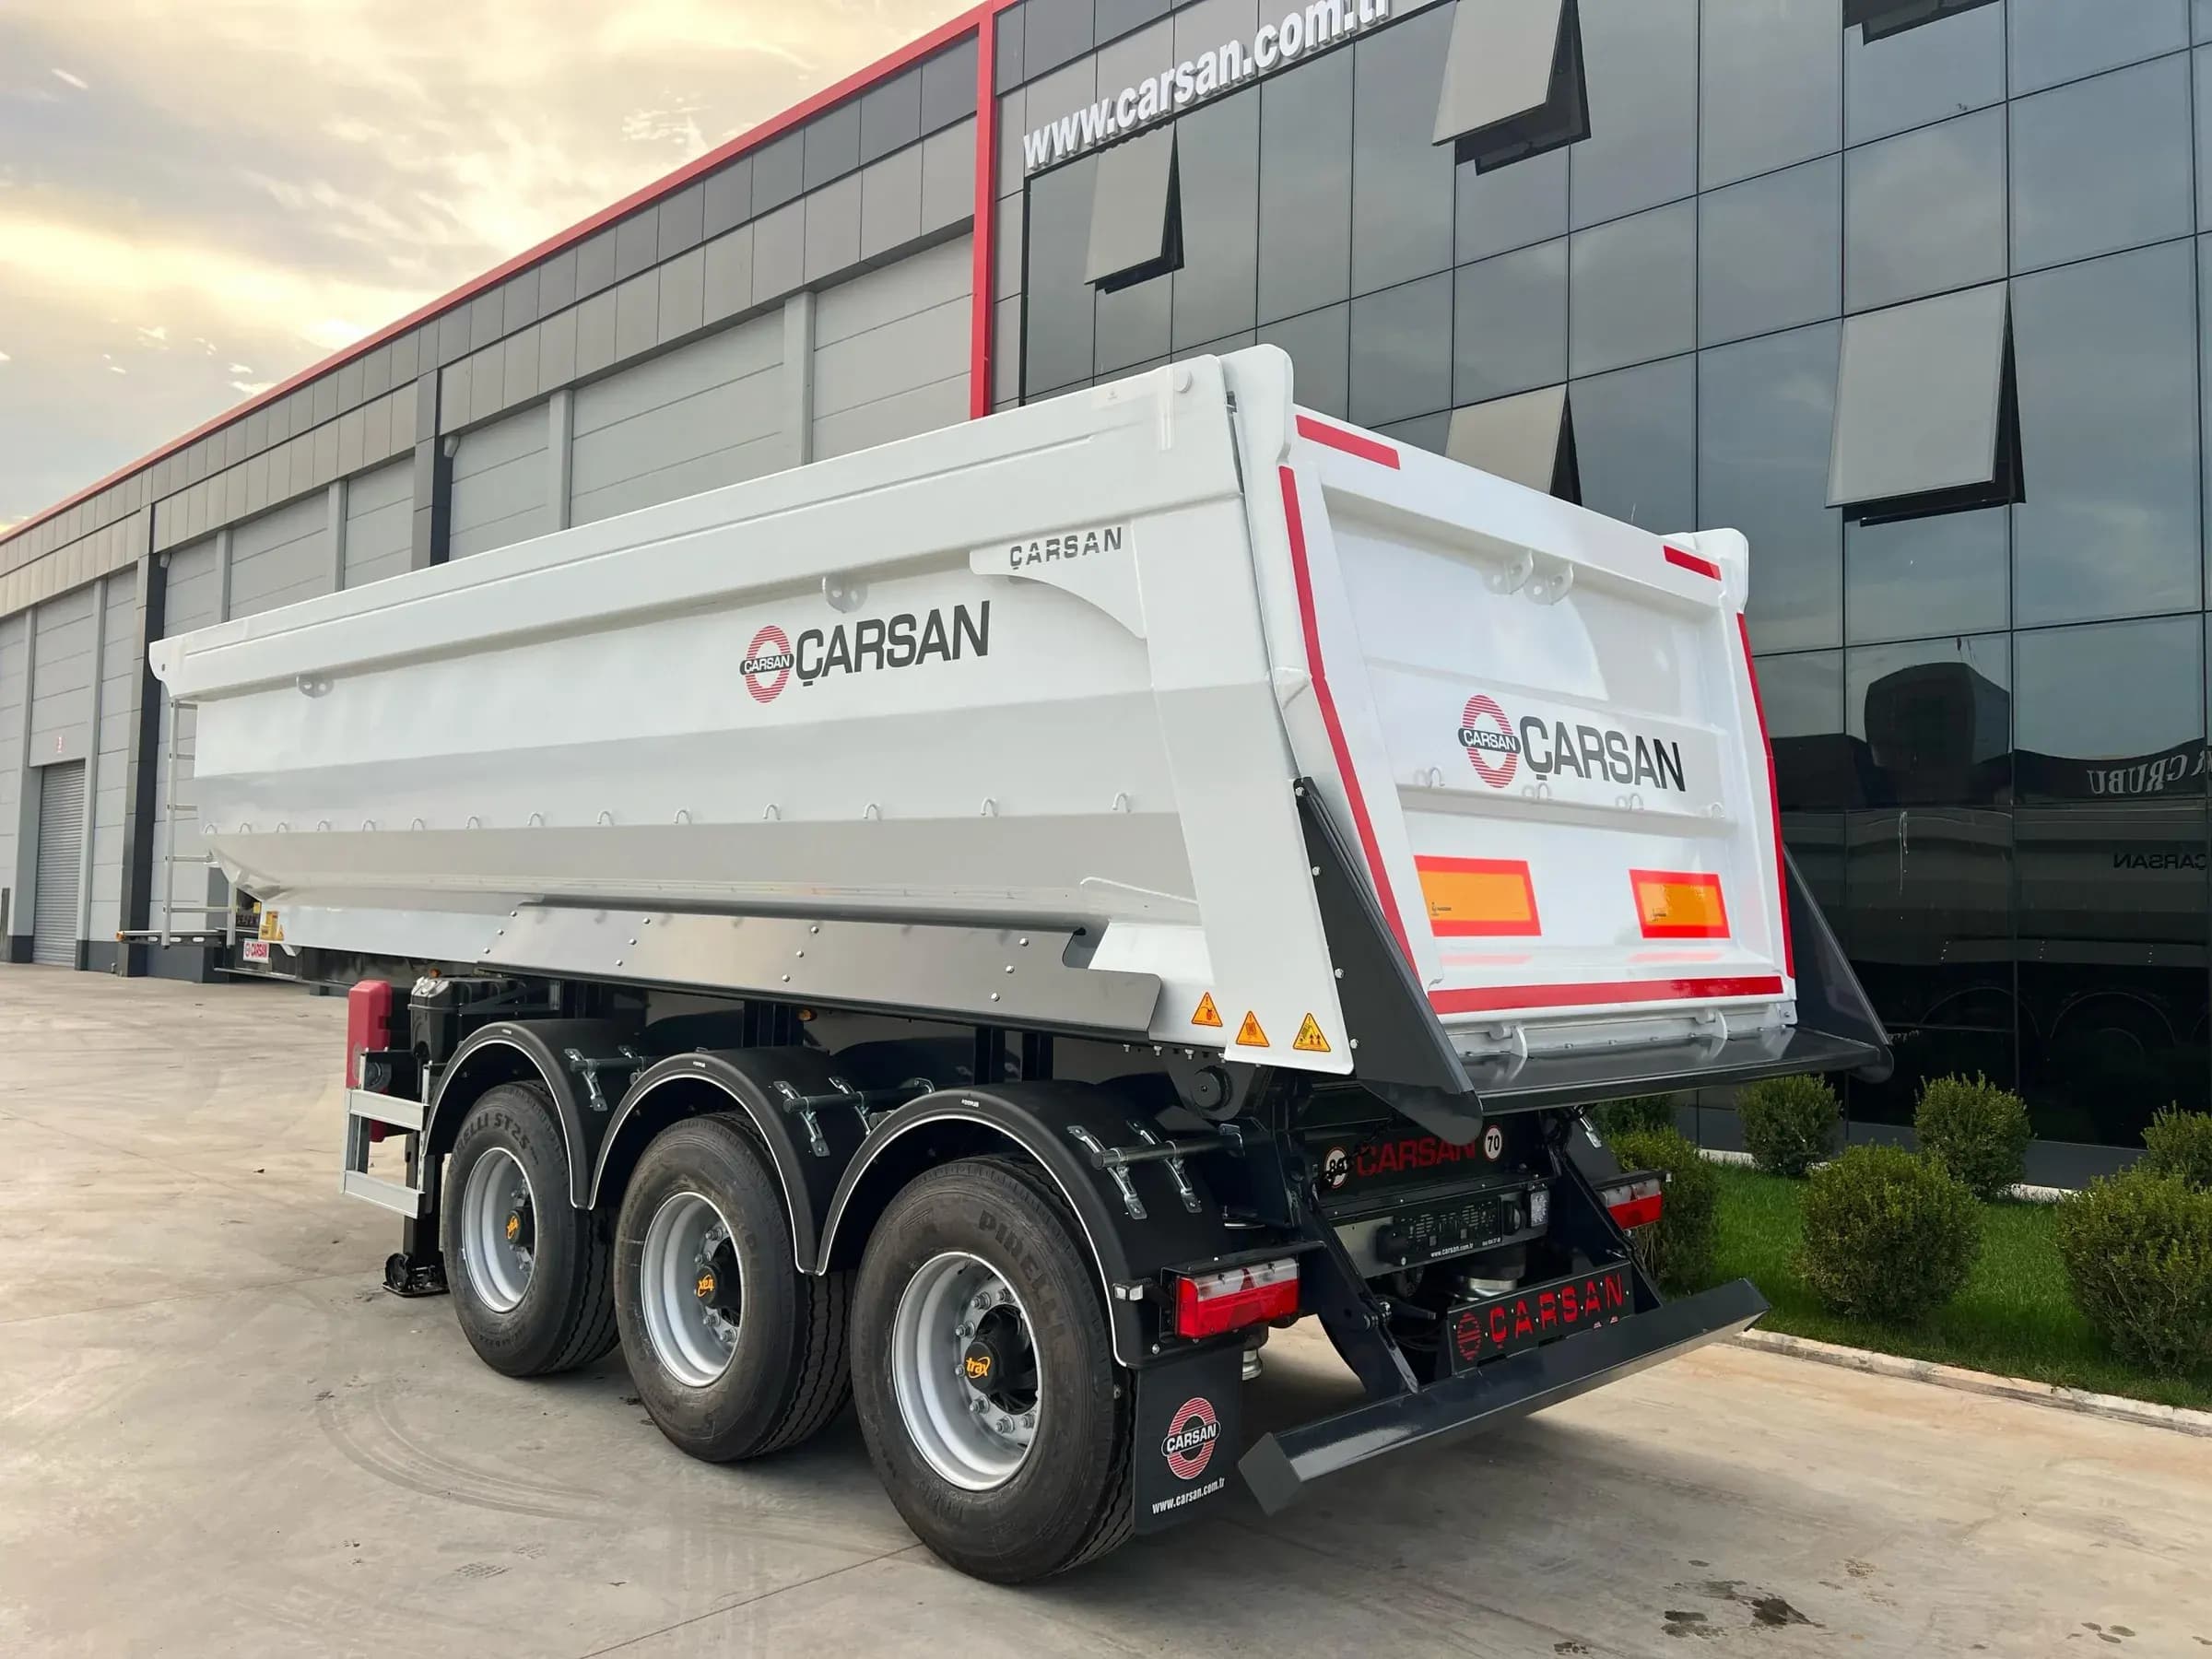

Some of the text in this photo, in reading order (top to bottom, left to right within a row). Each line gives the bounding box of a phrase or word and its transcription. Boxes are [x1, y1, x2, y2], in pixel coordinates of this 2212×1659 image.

[1010, 526, 1123, 570] ÇARSAN
[795, 600, 991, 688] ÇARSAN
[1519, 715, 1686, 793] ÇARSAN
[1488, 1135, 1500, 1152] 70
[1489, 1273, 1624, 1349] ÇARSAN
[1151, 1477, 1226, 1514] www.carsan.com.tr
